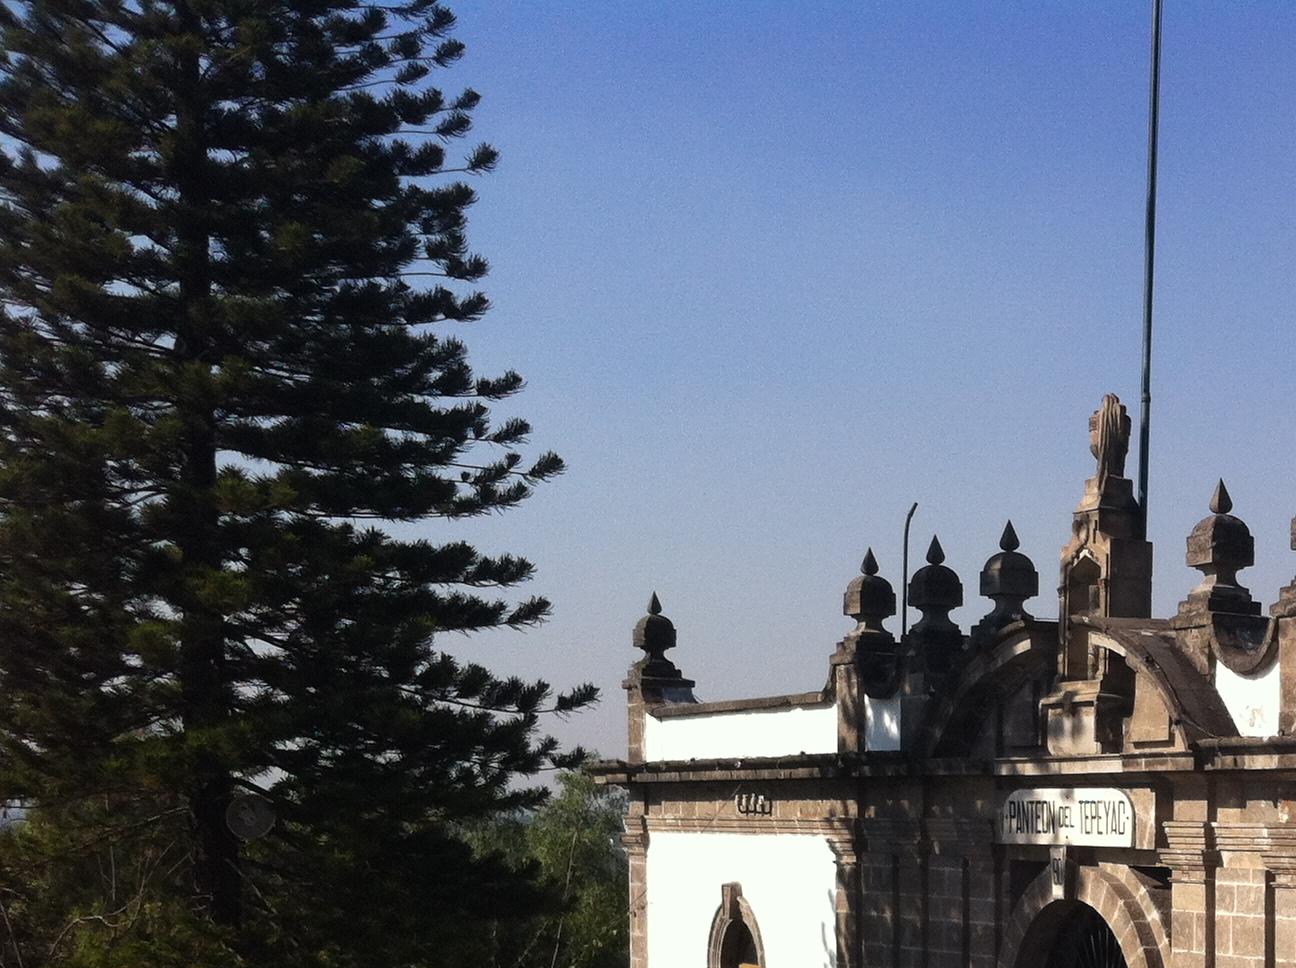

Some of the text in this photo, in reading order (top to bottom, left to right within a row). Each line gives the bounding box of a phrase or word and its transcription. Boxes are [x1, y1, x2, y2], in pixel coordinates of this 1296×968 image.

[1008, 800, 1125, 835] PANTEON DEL TEPEYAC
